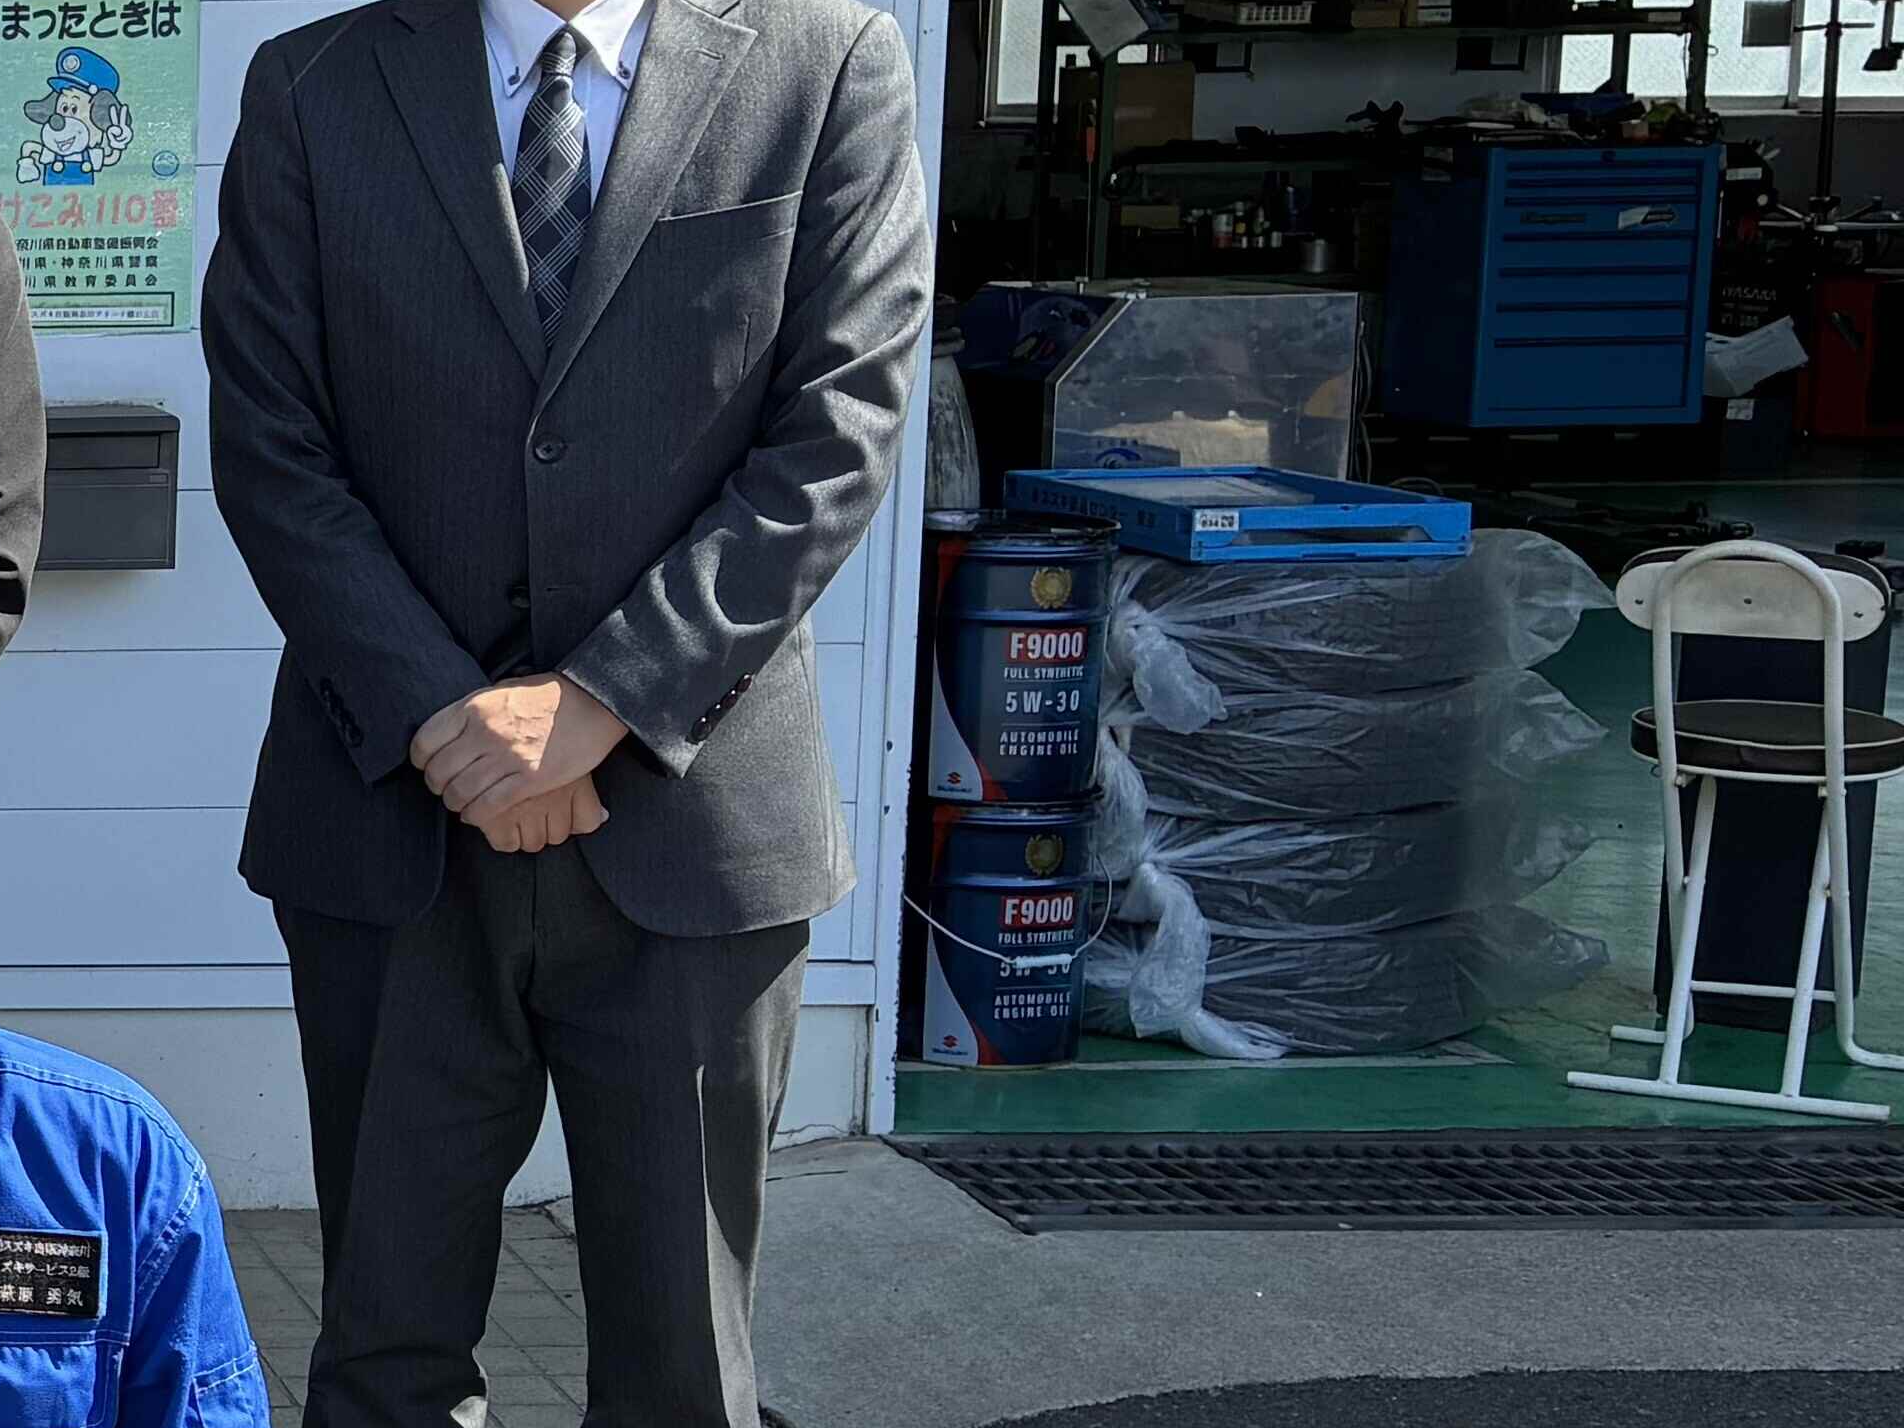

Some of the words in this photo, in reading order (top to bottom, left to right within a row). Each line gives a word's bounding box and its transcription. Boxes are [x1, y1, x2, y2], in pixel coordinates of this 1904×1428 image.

[1011, 632, 1083, 659] F9000
[1004, 666, 1029, 679] FULL
[1006, 690, 1079, 713] 5W-30
[1000, 730, 1079, 743] AUTOMOBILE
[1000, 744, 1052, 756] ENGINE
[1060, 742, 1077, 755] OIL
[1005, 896, 1073, 925] F9000
[998, 932, 1022, 944] FULL
